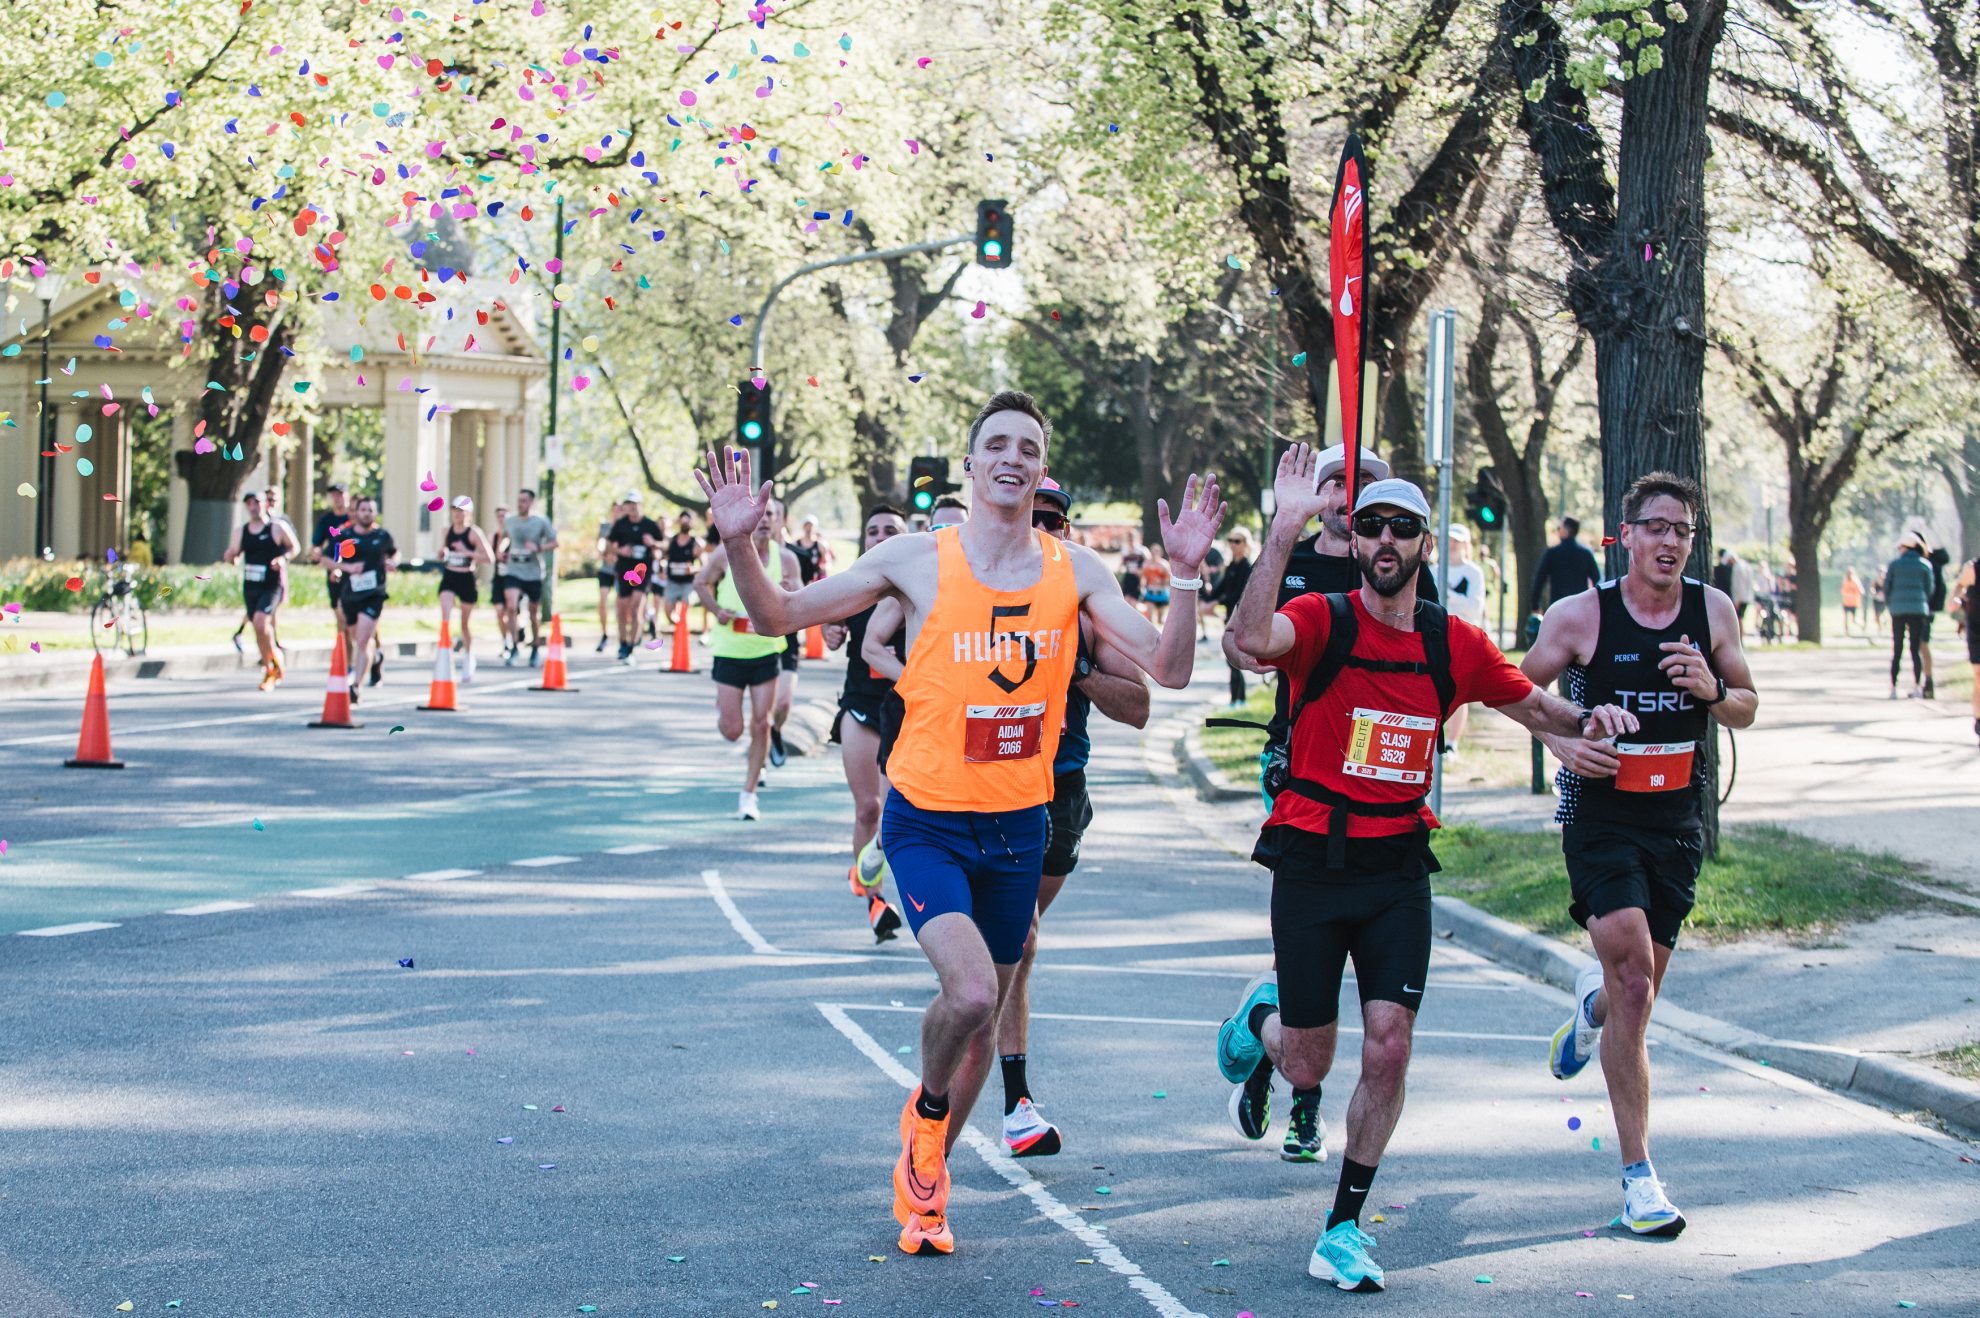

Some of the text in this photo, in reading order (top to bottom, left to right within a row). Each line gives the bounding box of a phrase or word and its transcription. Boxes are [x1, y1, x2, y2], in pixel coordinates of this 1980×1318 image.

[953, 629, 1063, 663] HUNTER
[987, 603, 1038, 694] 5
[1614, 653, 1640, 662] PERENE
[1615, 690, 1694, 712] TSRC
[997, 724, 1024, 739] AIDAN
[1356, 719, 1369, 748] ELITE
[1380, 731, 1411, 749] SLASH
[998, 740, 1022, 755] 2066
[1380, 748, 1406, 764] 3528
[1649, 774, 1665, 787] 190
